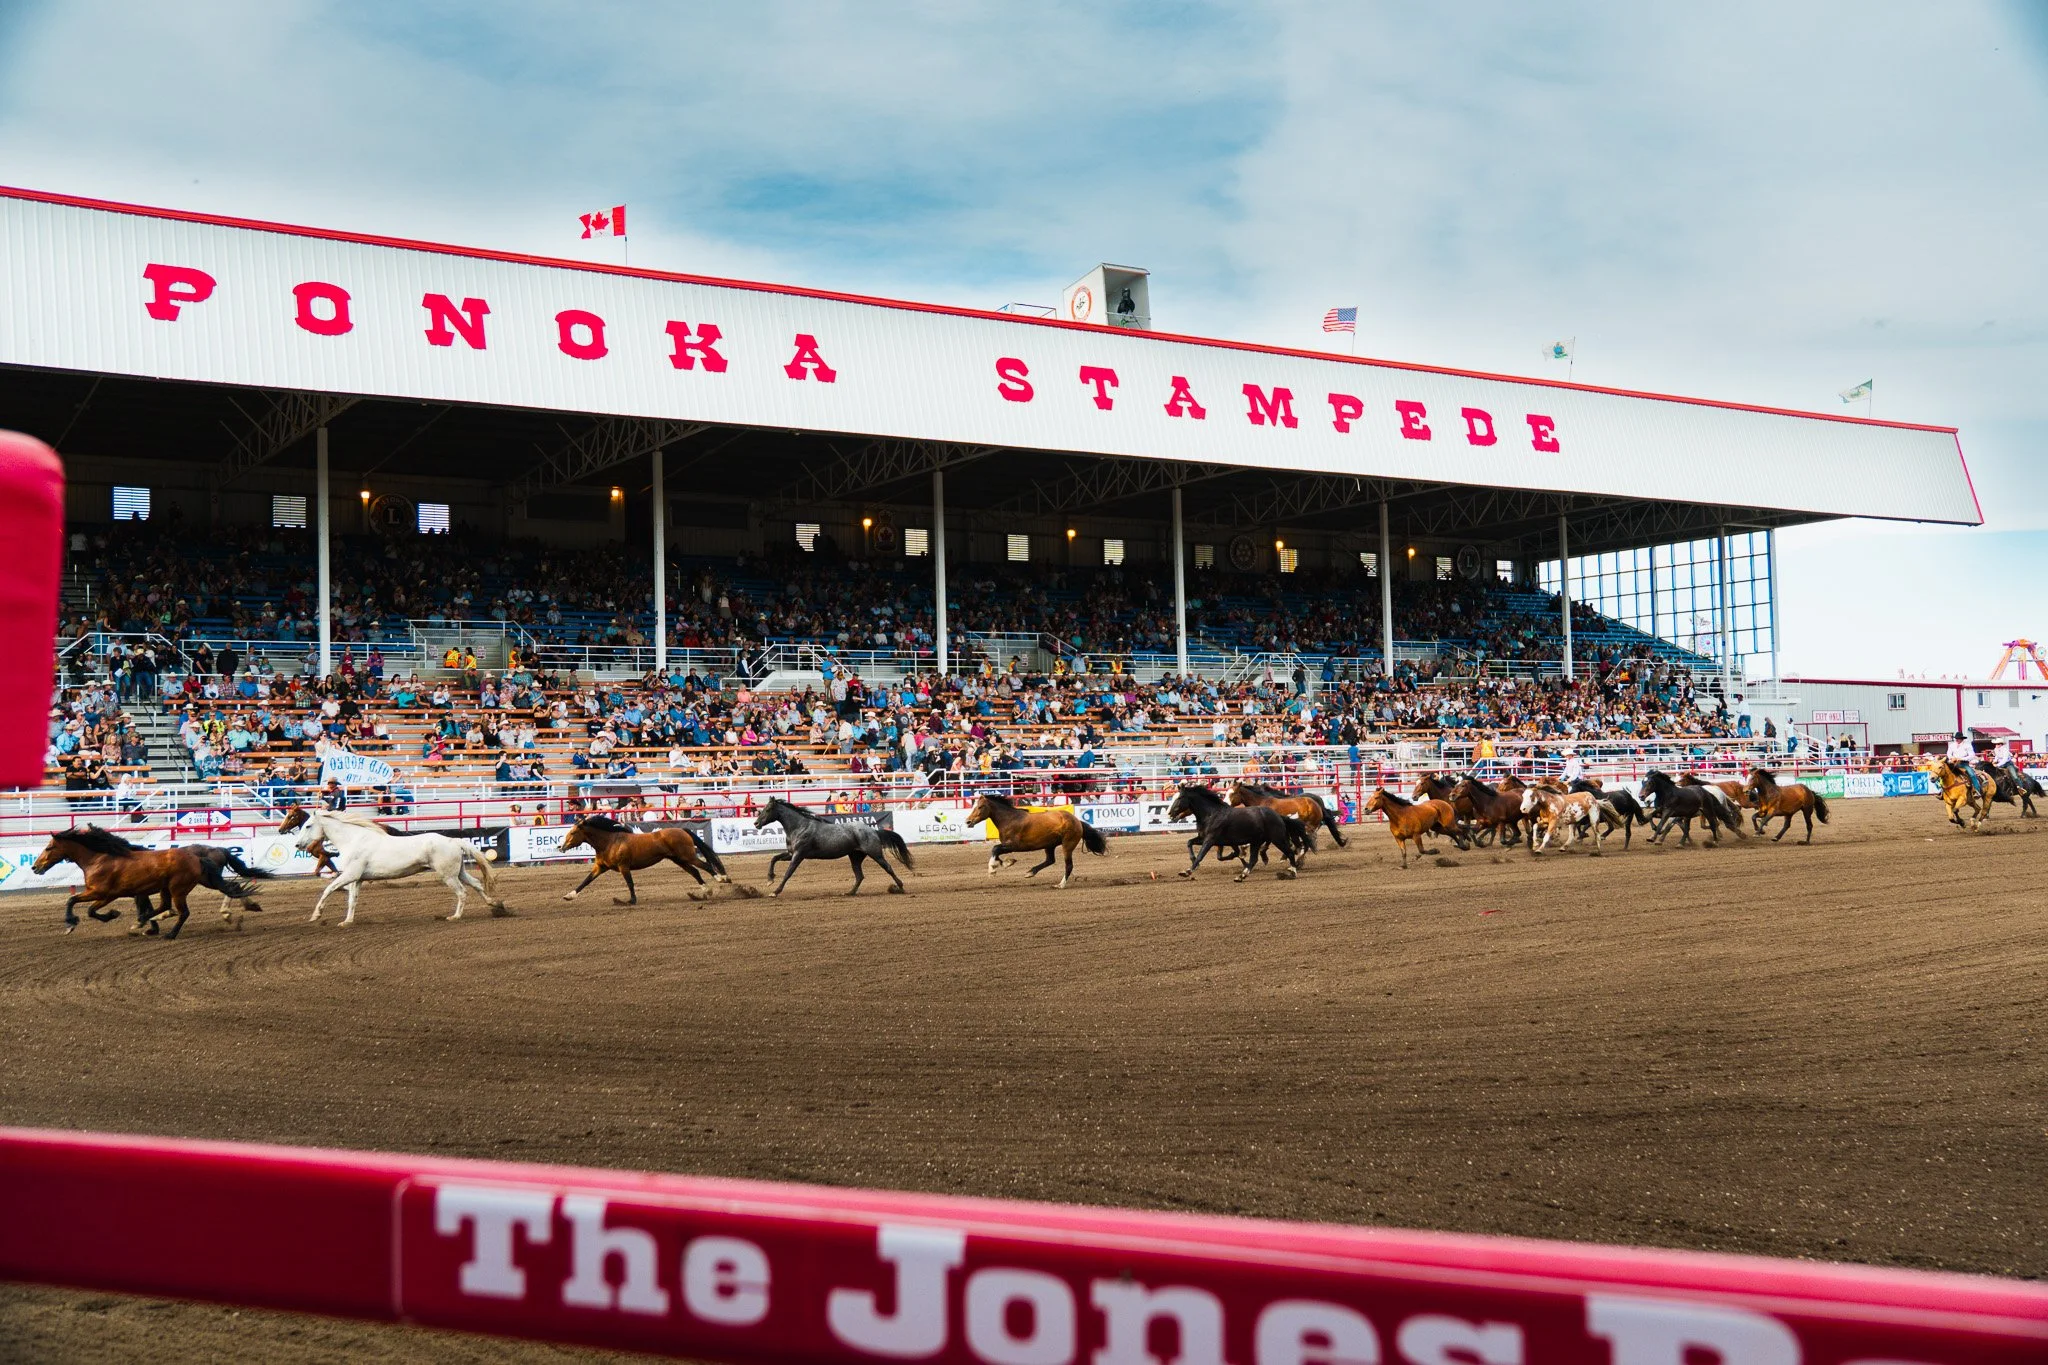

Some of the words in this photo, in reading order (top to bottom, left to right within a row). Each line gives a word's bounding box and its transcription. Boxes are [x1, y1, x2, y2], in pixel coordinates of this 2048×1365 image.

[143, 263, 837, 383] PONOKA
[996, 357, 1560, 453] STAMPEDE
[1095, 807, 1135, 819] TOMCO
[194, 817, 212, 825] SECTIN
[919, 823, 963, 833] LEGACY
[435, 1183, 772, 1327] The
[826, 1223, 1526, 1365] Jones
